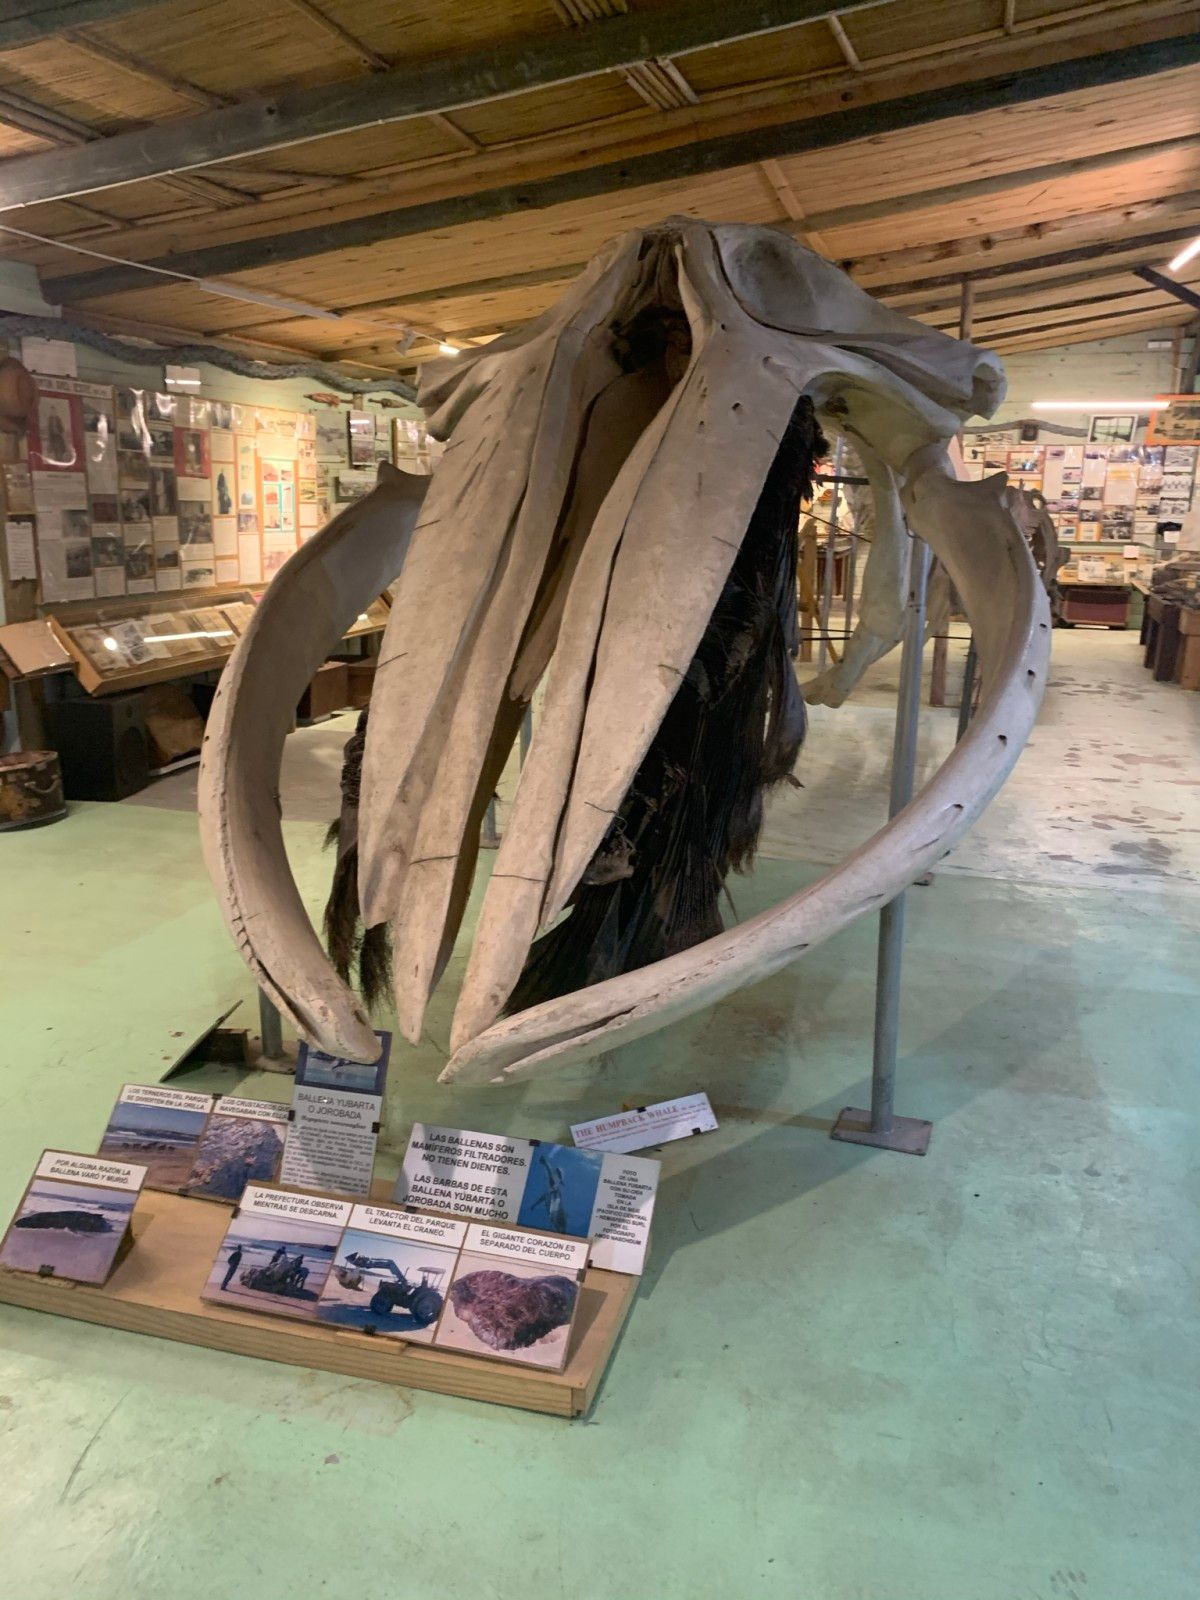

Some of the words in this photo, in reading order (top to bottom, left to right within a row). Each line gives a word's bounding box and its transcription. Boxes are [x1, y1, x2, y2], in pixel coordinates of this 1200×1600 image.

[298, 1093, 334, 1105] BALLENA
[337, 1098, 375, 1111] YUBARTA
[308, 1105, 314, 1113] O
[316, 1107, 361, 1120] JOROBADA
[576, 1128, 592, 1138] THE
[595, 1116, 645, 1133] HUMPBACK
[647, 1105, 678, 1119] WHALE
[430, 1133, 446, 1142] LAS
[448, 1135, 493, 1150] BALLENAS
[496, 1144, 515, 1153] SON
[70, 1162, 97, 1170] ALGUNA
[422, 1154, 436, 1162] NO
[438, 1156, 469, 1168] TIENEN
[470, 1161, 511, 1175] DIENTES.
[464, 1149, 527, 1167] FILTRADORES.
[50, 1166, 79, 1176] BALLENA
[414, 1174, 431, 1184] LAS
[433, 1177, 469, 1191] BARBAS
[471, 1183, 483, 1192] DE
[485, 1186, 508, 1197] ESTA
[254, 1200, 287, 1211] MIENTRAS
[265, 1193, 310, 1206] PREFECTURA
[310, 1199, 344, 1210] OBSERVA
[411, 1184, 452, 1199] BALLENA
[454, 1192, 495, 1209] YUBARTA
[497, 1199, 505, 1208] O
[403, 1195, 454, 1209] JOROBADA
[453, 1203, 473, 1213] SON
[475, 1206, 509, 1220] MUCHO
[369, 1218, 401, 1229] LEVANTA
[376, 1210, 409, 1221] TRACTOR
[410, 1215, 424, 1224] DEL
[426, 1218, 456, 1230] PARQUE
[480, 1239, 521, 1252] SEPARADO
[522, 1246, 536, 1255] DEL
[493, 1232, 525, 1244] GIGANTE
